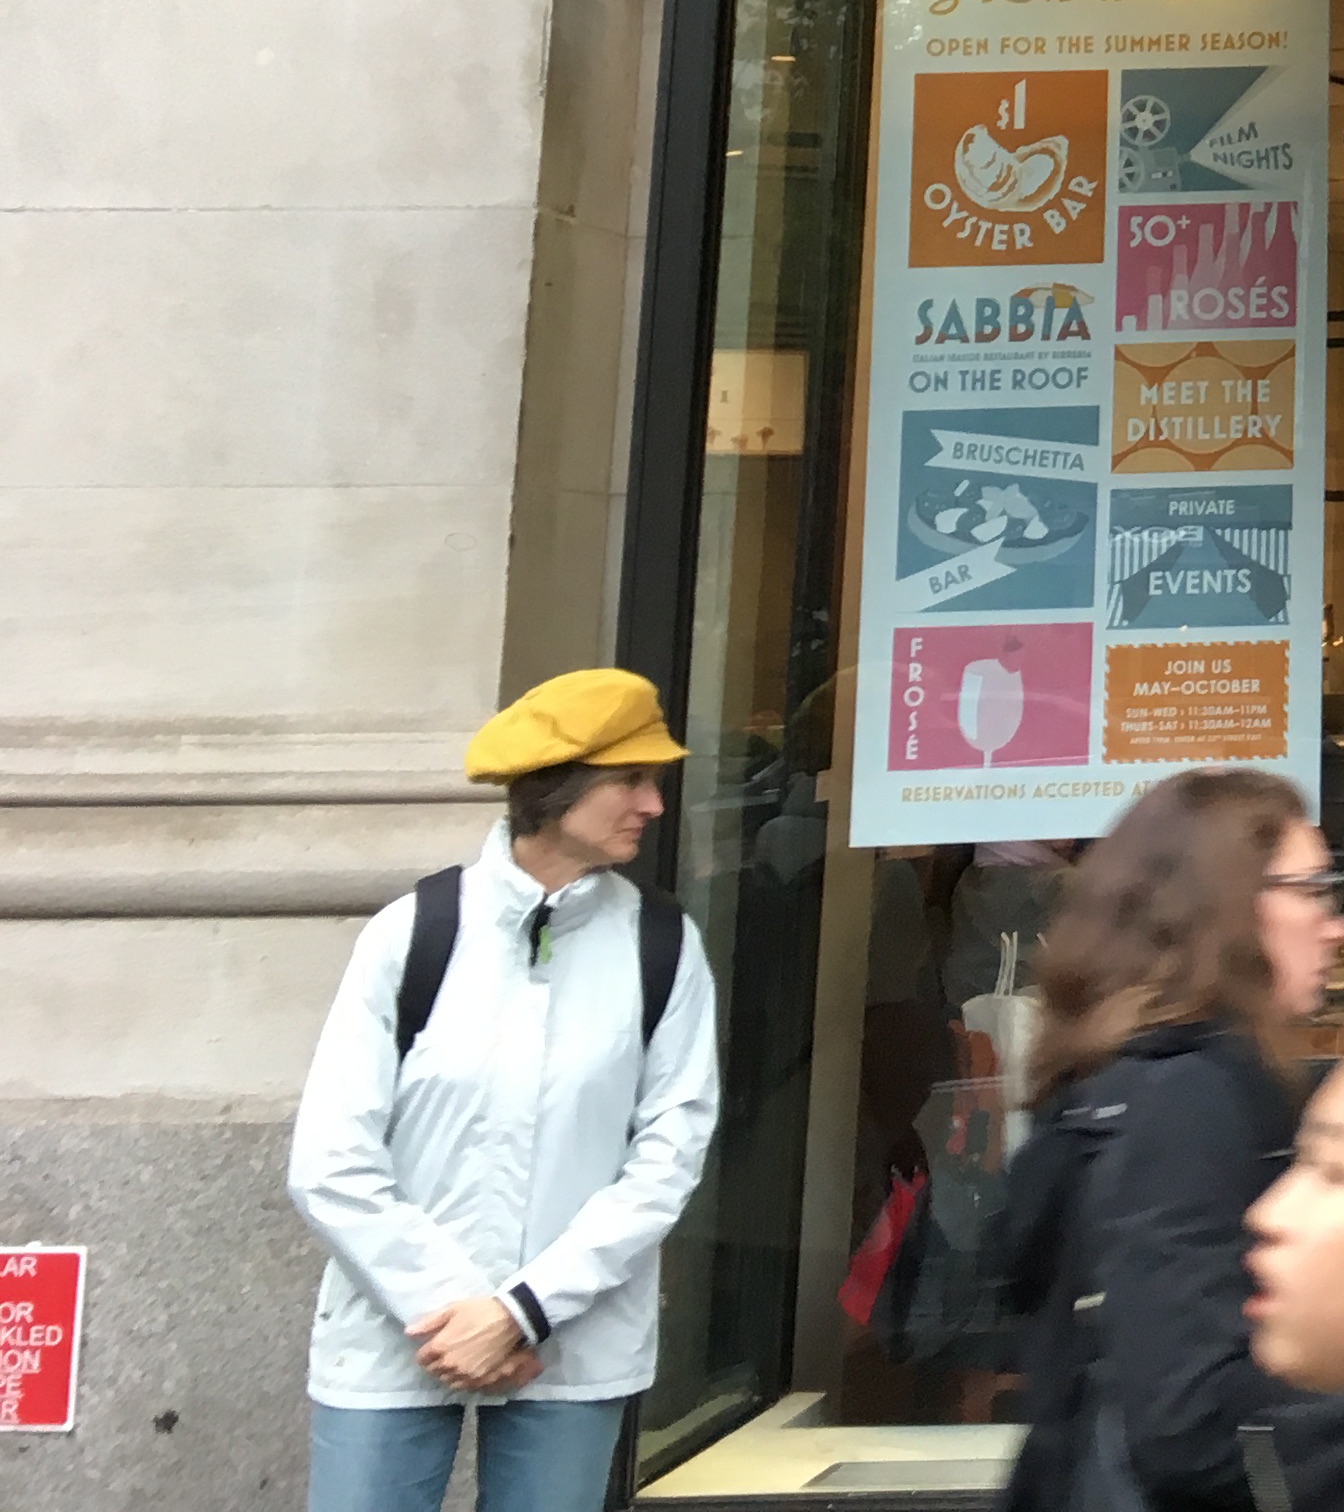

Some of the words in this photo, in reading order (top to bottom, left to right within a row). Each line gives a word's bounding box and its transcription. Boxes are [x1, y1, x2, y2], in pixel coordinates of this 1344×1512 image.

[926, 36, 989, 57] OPEN
[1000, 35, 1047, 56] FOR
[1057, 35, 1094, 55] THE
[1104, 33, 1191, 54] SUMMER
[1200, 31, 1289, 51] SEASON!
[1208, 121, 1260, 150] FILM
[1212, 142, 1294, 171] NIGHTS
[922, 182, 1035, 251] OYSTER
[1043, 174, 1100, 235] BAR
[1129, 213, 1191, 249] 50+
[1170, 277, 1290, 322] ROSÉS
[914, 294, 1093, 346] SABBIA
[909, 369, 949, 393] ON
[958, 369, 1003, 392] THE
[1011, 366, 1089, 390] ROOF
[1139, 381, 1211, 406] MEET
[1222, 379, 1271, 403] THE
[1126, 413, 1282, 443] DISTILLERY
[950, 441, 1085, 472] BRUSCHETTA
[1168, 499, 1236, 517] PRIVATE
[928, 563, 974, 596] BAR
[1147, 568, 1253, 597] EVENTS
[1164, 660, 1205, 676] JOIN
[1211, 658, 1233, 674] US
[902, 783, 1027, 803] RESERVATIONS
[1032, 780, 1125, 799] ACCEPTED
